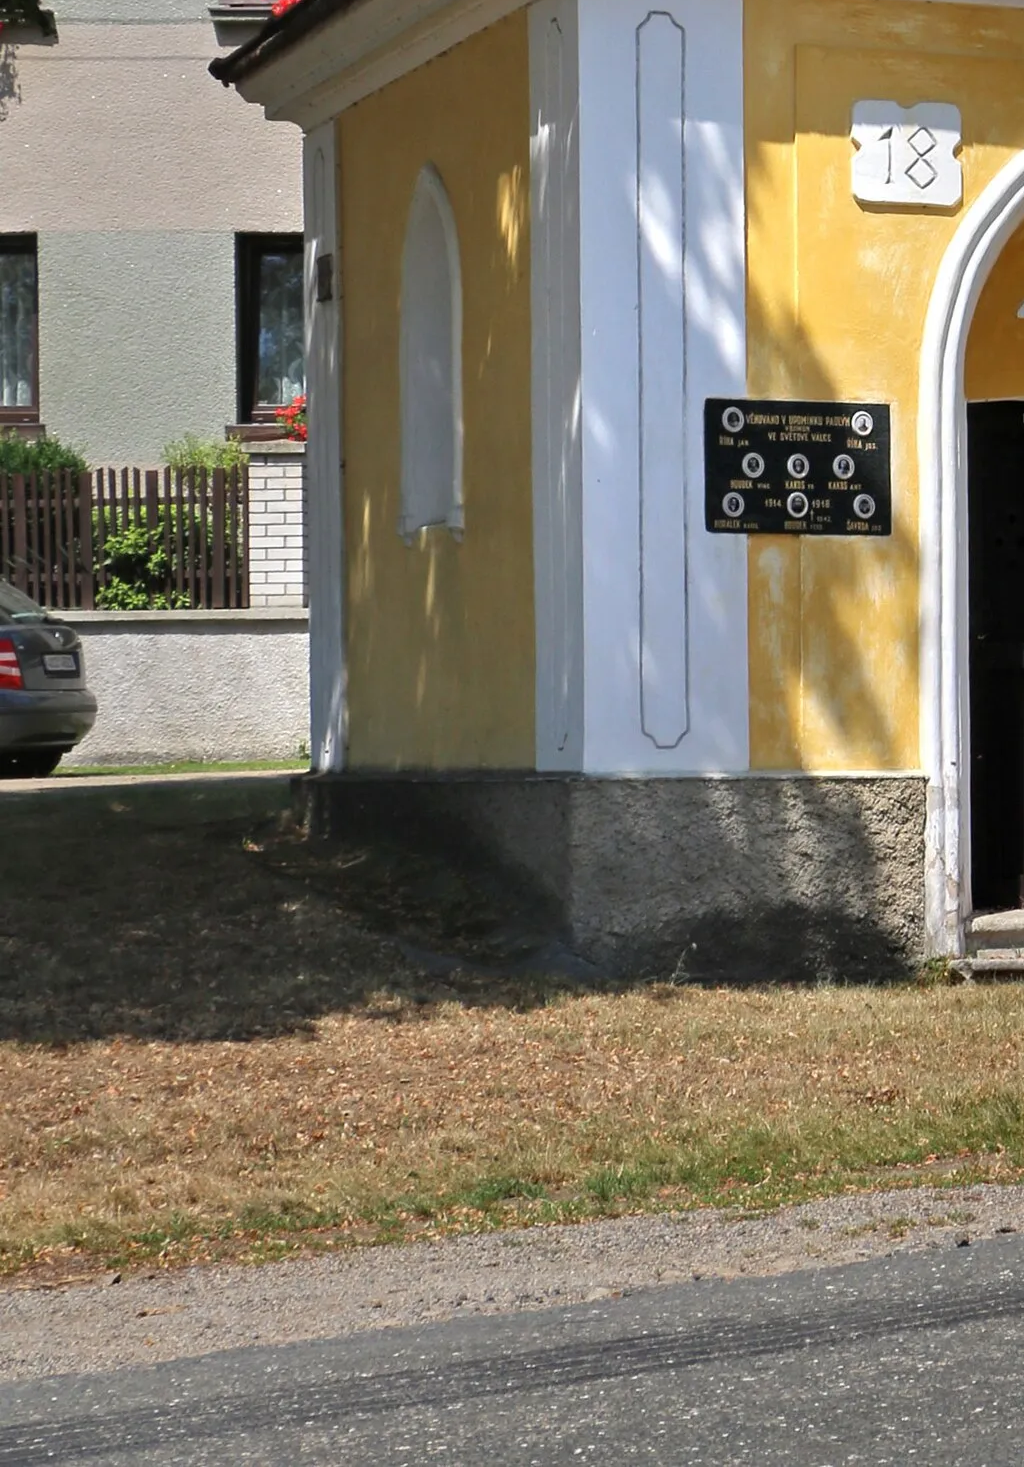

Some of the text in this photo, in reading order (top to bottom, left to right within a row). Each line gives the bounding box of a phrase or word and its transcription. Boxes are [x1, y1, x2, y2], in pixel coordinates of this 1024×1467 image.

[877, 126, 939, 191] 18
[781, 414, 787, 425] V
[767, 432, 776, 441] VE
